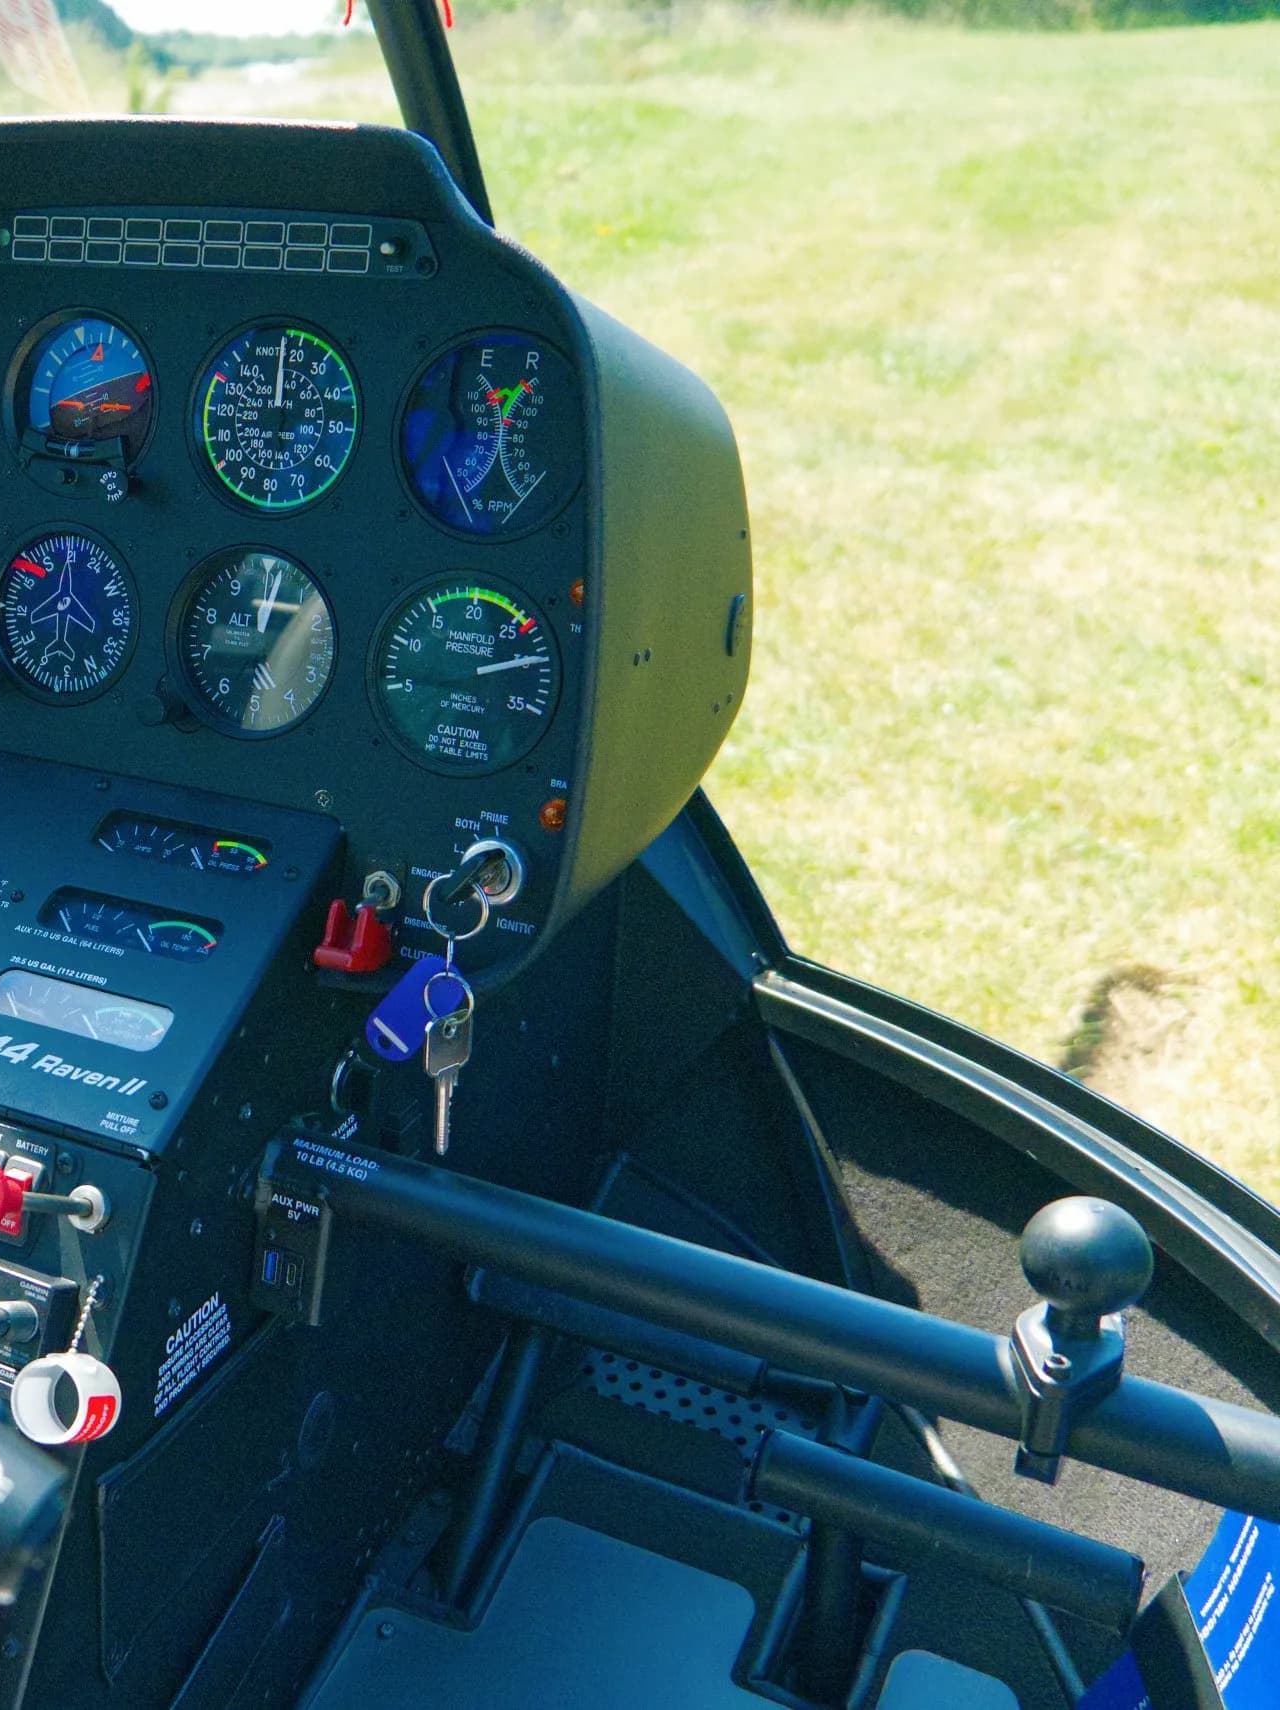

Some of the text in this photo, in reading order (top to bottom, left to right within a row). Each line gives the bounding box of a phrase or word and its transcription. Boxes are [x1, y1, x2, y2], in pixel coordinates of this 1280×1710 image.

[289, 350, 304, 363] 20
[481, 349, 494, 367] E
[526, 351, 539, 370] R
[240, 365, 258, 377] 140
[311, 362, 326, 375] 30
[225, 384, 243, 395] 130
[256, 385, 272, 395] 260
[285, 380, 296, 389] 40
[300, 391, 311, 399] 60
[324, 388, 340, 400] 40
[531, 395, 543, 404] 110
[217, 405, 234, 416] 120
[305, 408, 315, 417] 80
[471, 404, 485, 413] 100
[522, 407, 537, 416] 100
[329, 421, 344, 433] 50
[476, 417, 489, 426] 90
[516, 421, 528, 429] 90
[218, 429, 230, 442] 110
[244, 428, 260, 437] 200
[300, 425, 313, 434] 100
[477, 431, 488, 440] 80
[251, 439, 263, 448] 180
[512, 435, 524, 443] 80
[225, 449, 242, 462] 100
[258, 449, 272, 458] 160
[294, 445, 307, 453] 120
[474, 446, 484, 454] 70
[514, 449, 525, 457] 70
[275, 452, 289, 461] 140
[314, 455, 330, 468] 60
[465, 458, 477, 466] 60
[457, 468, 468, 477] 50
[518, 462, 530, 470] 60
[241, 467, 255, 480] 90
[523, 474, 536, 483] 50
[263, 479, 277, 491] 80
[290, 474, 305, 487] 70
[472, 500, 513, 512] % RPM
[43, 556, 54, 572] S
[86, 557, 100, 574] 24
[104, 579, 120, 597] W
[230, 580, 241, 596] 9
[112, 608, 123, 626] 30
[206, 608, 217, 624] 8
[466, 605, 482, 620] 20
[228, 613, 252, 627] ALT
[312, 615, 322, 632] 2
[432, 615, 444, 629] 15
[20, 630, 35, 645] E
[449, 630, 494, 645] MANIFOLD
[499, 625, 516, 639] 25
[103, 637, 118, 655] 33
[410, 639, 421, 652] 10
[446, 642, 494, 657] PRESSURE
[201, 644, 211, 661] 7
[84, 655, 97, 673] N
[306, 665, 316, 682] 3
[220, 678, 230, 694] 6
[404, 680, 413, 692] 5
[250, 695, 260, 711] 5
[284, 689, 296, 704] 4
[450, 693, 477, 703] INCHES
[507, 696, 524, 710] 35
[441, 700, 485, 714] OF MERCURY
[438, 724, 479, 739] CAUTION
[428, 735, 487, 750] DO NOT EXCEED
[425, 744, 488, 760] MP TABLE LIMITS
[455, 818, 480, 831] BOTH
[480, 811, 509, 825] PRIME
[14, 925, 32, 934] AUX
[62, 936, 78, 944] GAL
[93, 943, 124, 957] LITERS)
[27, 959, 39, 968] US
[40, 963, 56, 972] GAL
[57, 967, 75, 976] (112
[75, 972, 107, 985] LITERS)
[32, 1054, 121, 1090] Raven
[117, 1078, 148, 1096] II
[106, 1111, 140, 1126] MIXTURE
[99, 1119, 137, 1136] PULL OFF
[16, 1139, 49, 1156] BATTERY
[293, 1138, 380, 1171] MAXIMUM LOAD:
[296, 1151, 368, 1181] 10 LB (4.5 KG)
[272, 1193, 320, 1216] AUX PWR
[287, 1209, 301, 1221] 5V
[166, 1291, 219, 1354] CAUTION
[208, 1314, 228, 1336] CLEAR
